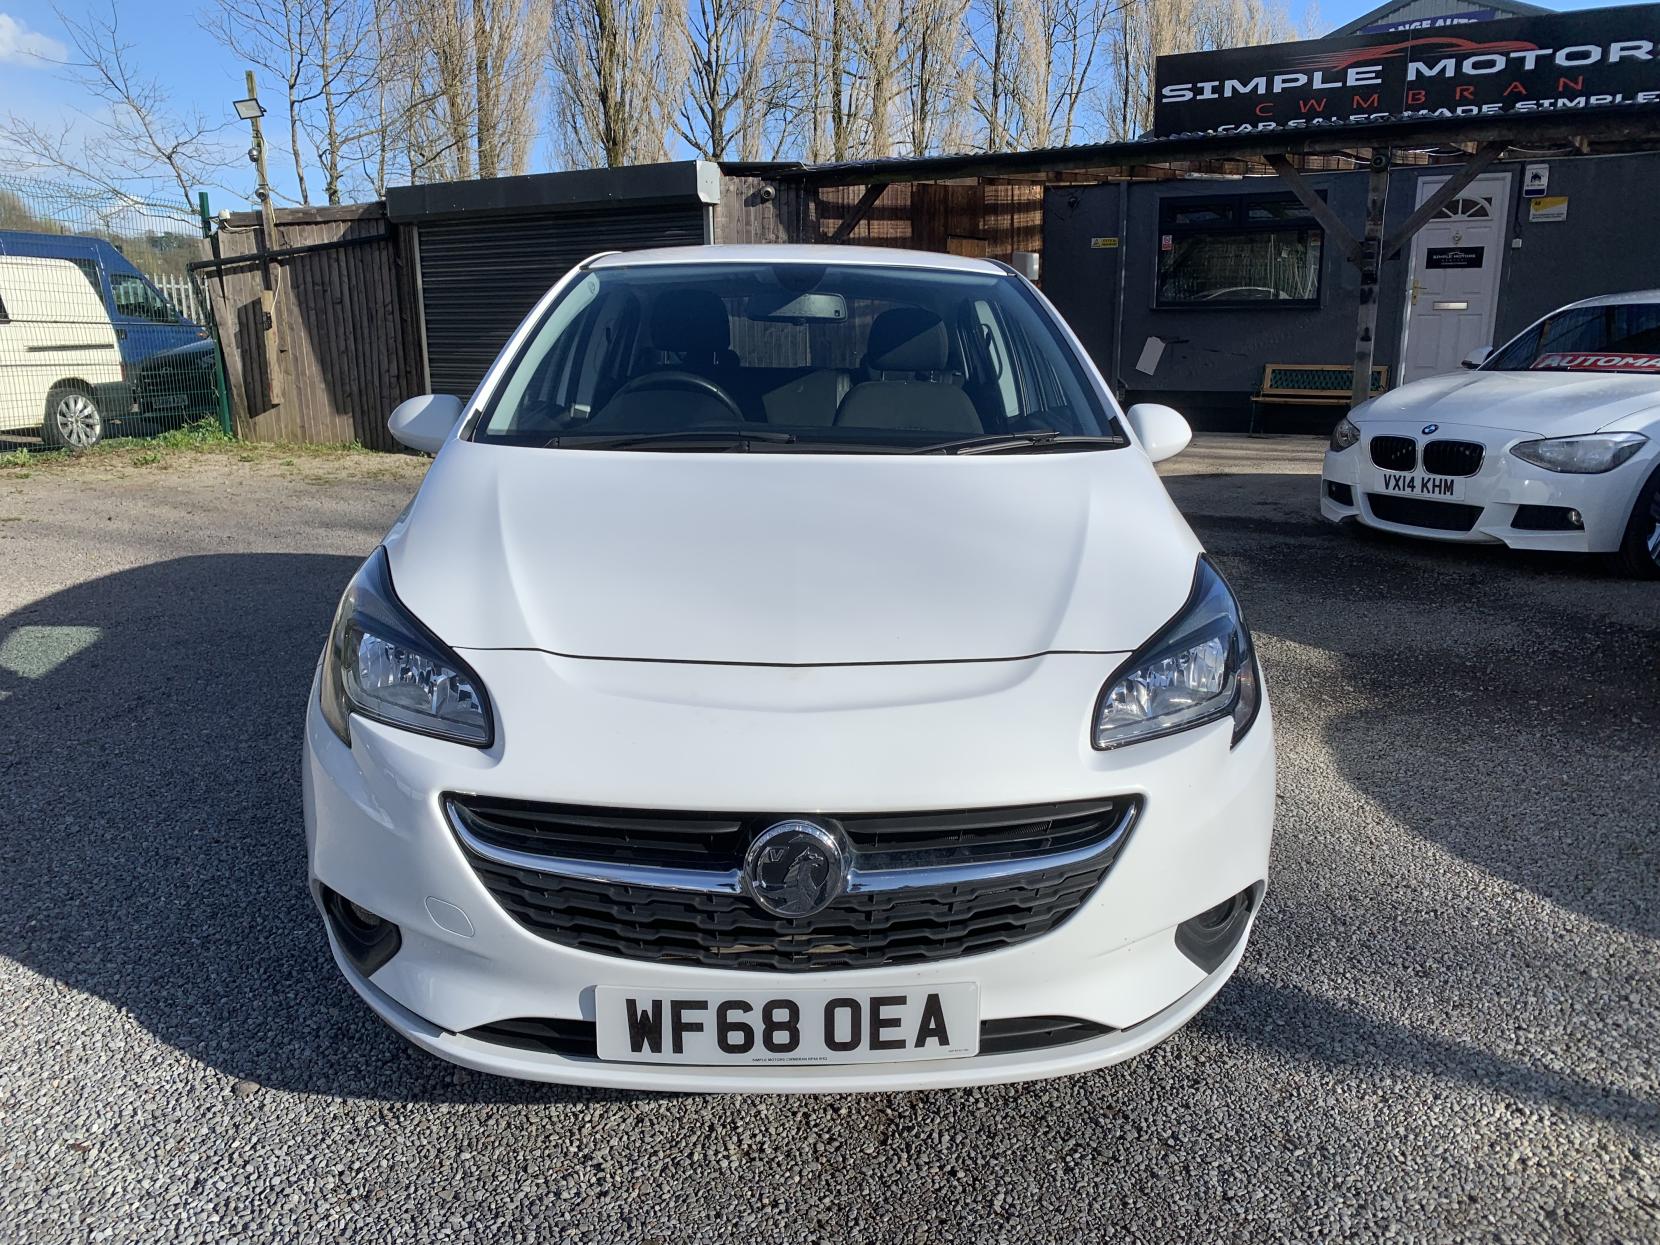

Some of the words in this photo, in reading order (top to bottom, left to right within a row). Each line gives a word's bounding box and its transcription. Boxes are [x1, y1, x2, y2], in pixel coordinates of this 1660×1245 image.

[1162, 65, 1383, 103] SIMPLE
[1407, 40, 1660, 81] MOTOR
[1255, 75, 1584, 117] CWMBRAN
[1515, 90, 1660, 113] SIMPLE
[1384, 474, 1416, 493] VX14
[1420, 477, 1455, 496] KHM
[625, 997, 801, 1054] WF68
[823, 993, 951, 1052] OEA
